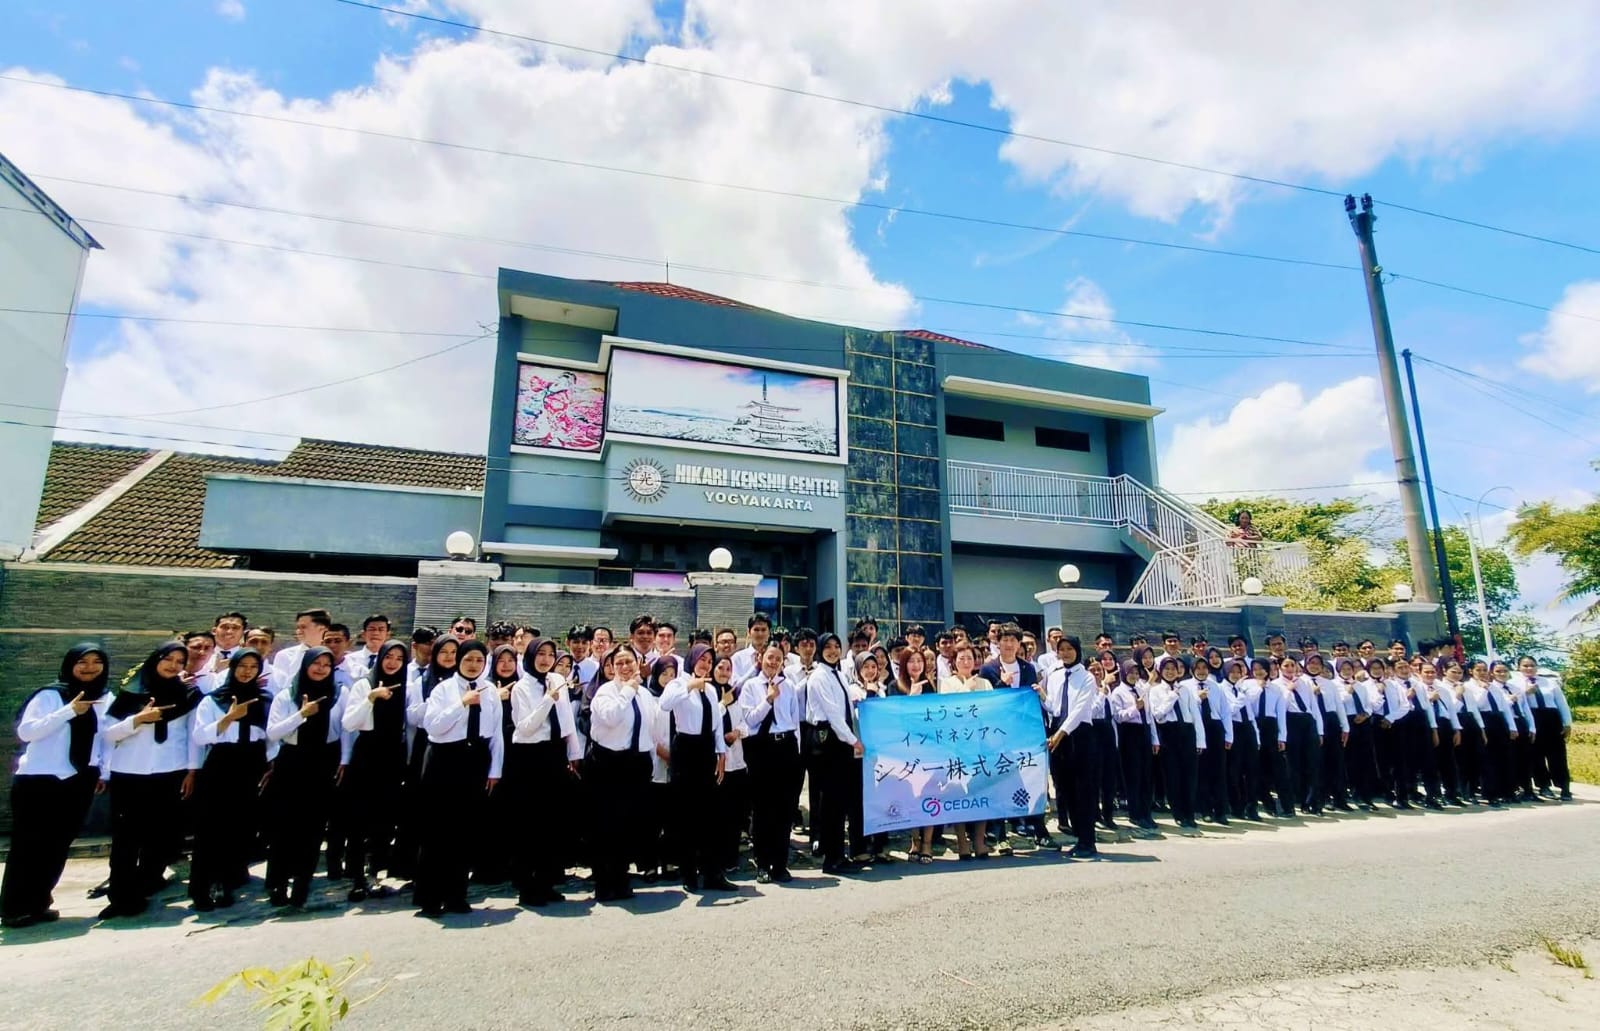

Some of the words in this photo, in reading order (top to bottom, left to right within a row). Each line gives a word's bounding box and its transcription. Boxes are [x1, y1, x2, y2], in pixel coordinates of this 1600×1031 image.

[674, 463, 728, 486] HIKARI
[730, 469, 787, 493] KENSHU
[788, 475, 840, 498] CENTER
[704, 490, 814, 512] YOGYAKARTA
[923, 704, 979, 722] ようこそ
[901, 726, 1007, 747] インドネシアへ
[874, 751, 1039, 783] シダー株式会社
[943, 797, 990, 812] CEDAR
